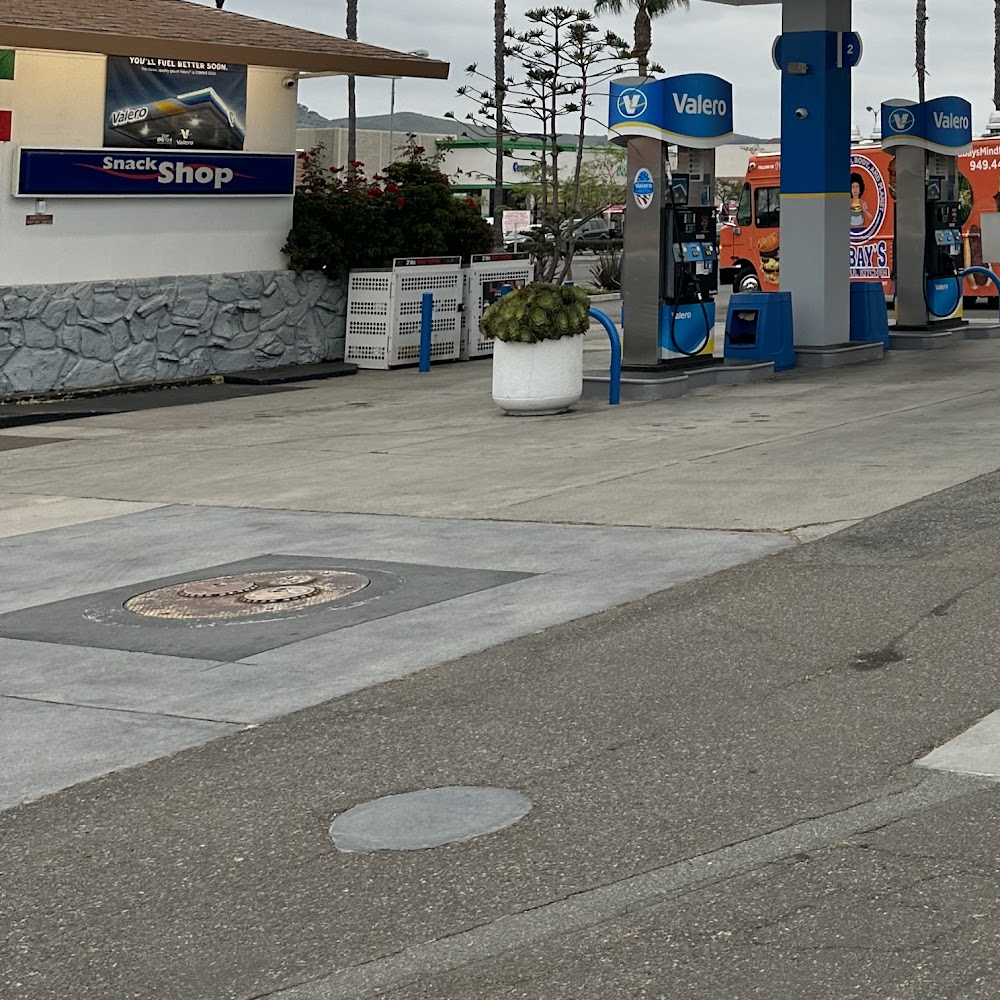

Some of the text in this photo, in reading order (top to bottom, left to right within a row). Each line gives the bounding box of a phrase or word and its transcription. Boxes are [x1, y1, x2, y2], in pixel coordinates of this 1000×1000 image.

[846, 43, 854, 55] 2
[157, 58, 176, 68] FUEL
[177, 60, 205, 69] BETTER
[672, 92, 727, 116] Valero
[112, 106, 148, 126] Valero
[933, 111, 969, 130] Valero
[102, 155, 234, 189] Snack Shop
[711, 210, 716, 219] 2
[850, 240, 888, 268] BAY'S
